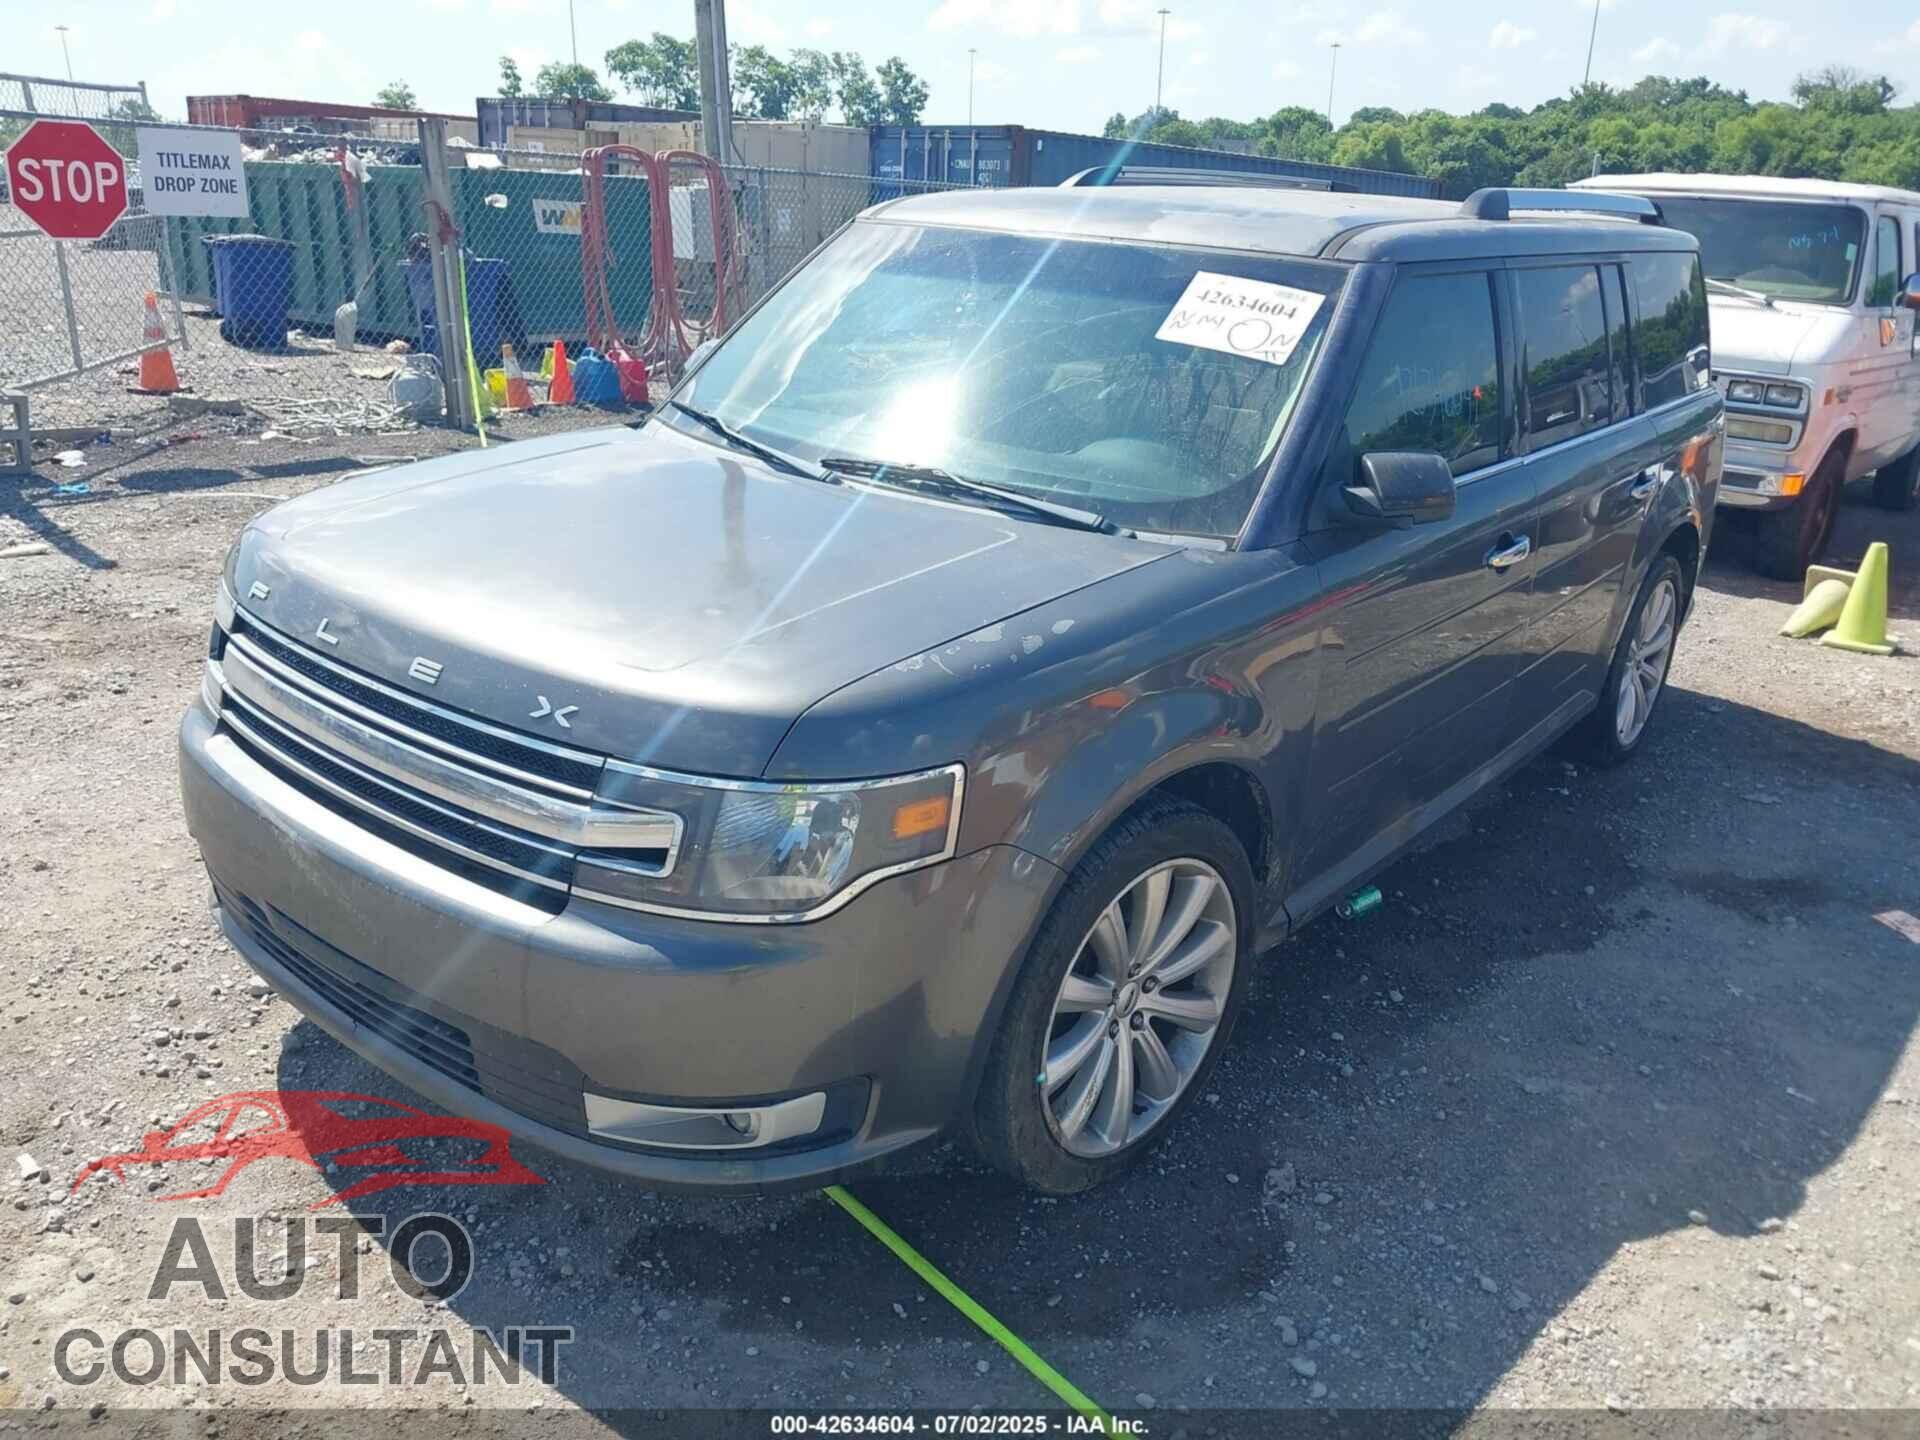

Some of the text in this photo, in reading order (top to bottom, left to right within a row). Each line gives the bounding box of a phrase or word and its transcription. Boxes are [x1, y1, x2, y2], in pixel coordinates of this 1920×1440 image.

[156, 151, 232, 170] TITLEMAX
[17, 157, 119, 203] STOP
[154, 176, 239, 194] DROP ZONE
[1196, 288, 1298, 320] 42634604
[248, 579, 579, 729] FLEX
